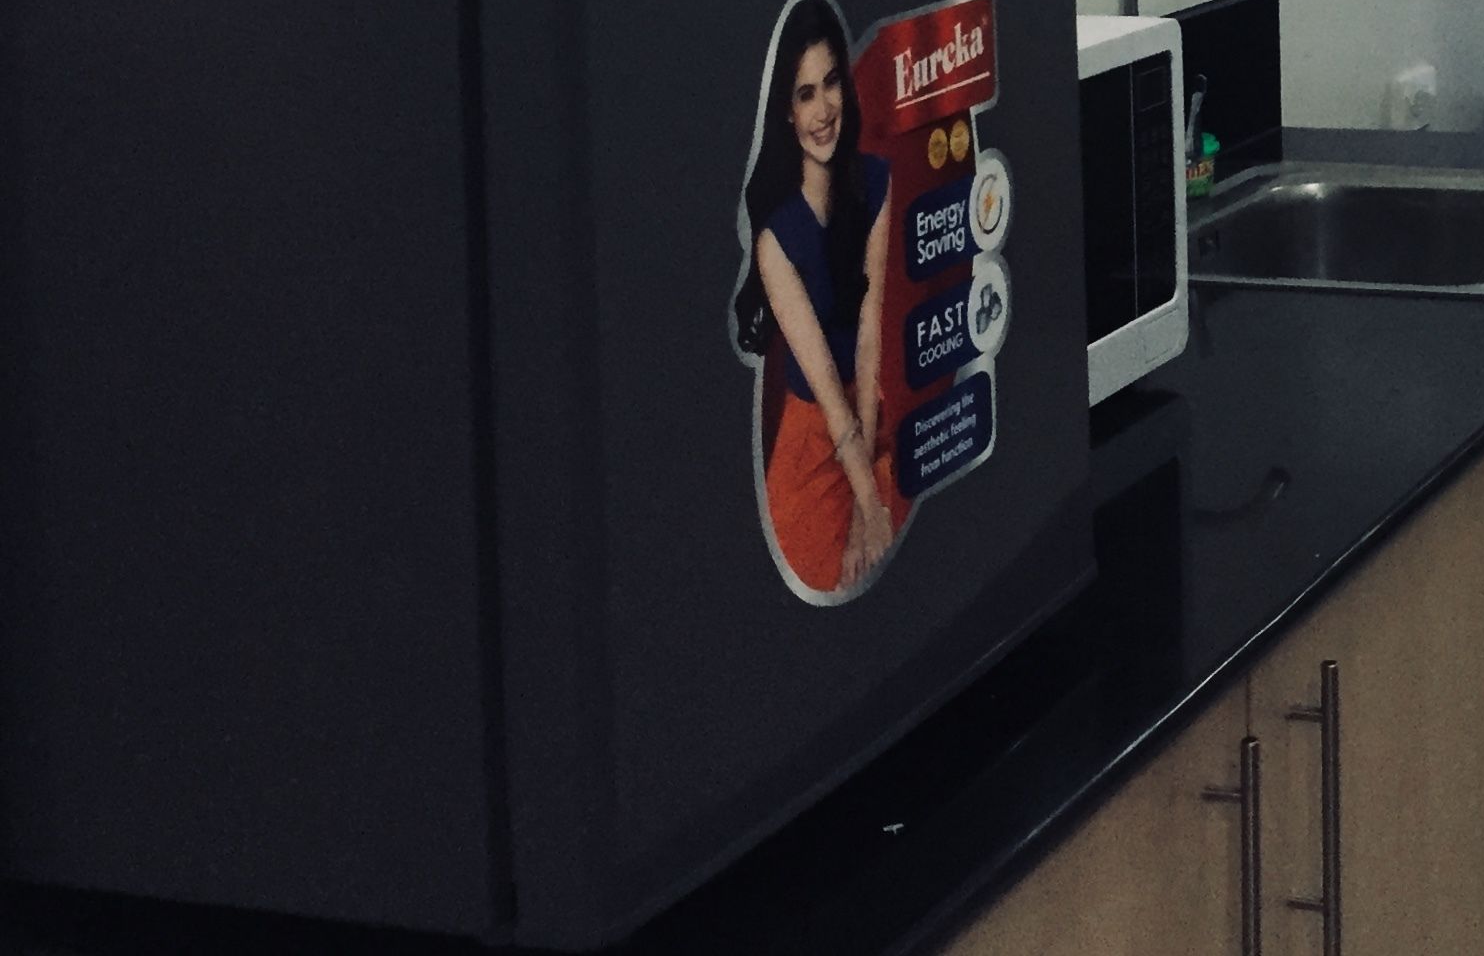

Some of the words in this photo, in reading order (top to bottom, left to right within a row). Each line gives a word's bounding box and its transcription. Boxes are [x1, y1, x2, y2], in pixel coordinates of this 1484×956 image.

[893, 22, 984, 101] Eureka
[917, 200, 966, 236] Energy
[917, 227, 965, 264] Saving
[917, 301, 964, 347] FAST
[919, 332, 963, 367] COOLING
[915, 402, 960, 436] Discovering
[961, 393, 975, 408] the
[913, 430, 949, 459] aesthetic
[951, 414, 976, 435] feeling
[921, 458, 940, 477] from
[942, 438, 973, 463] function
